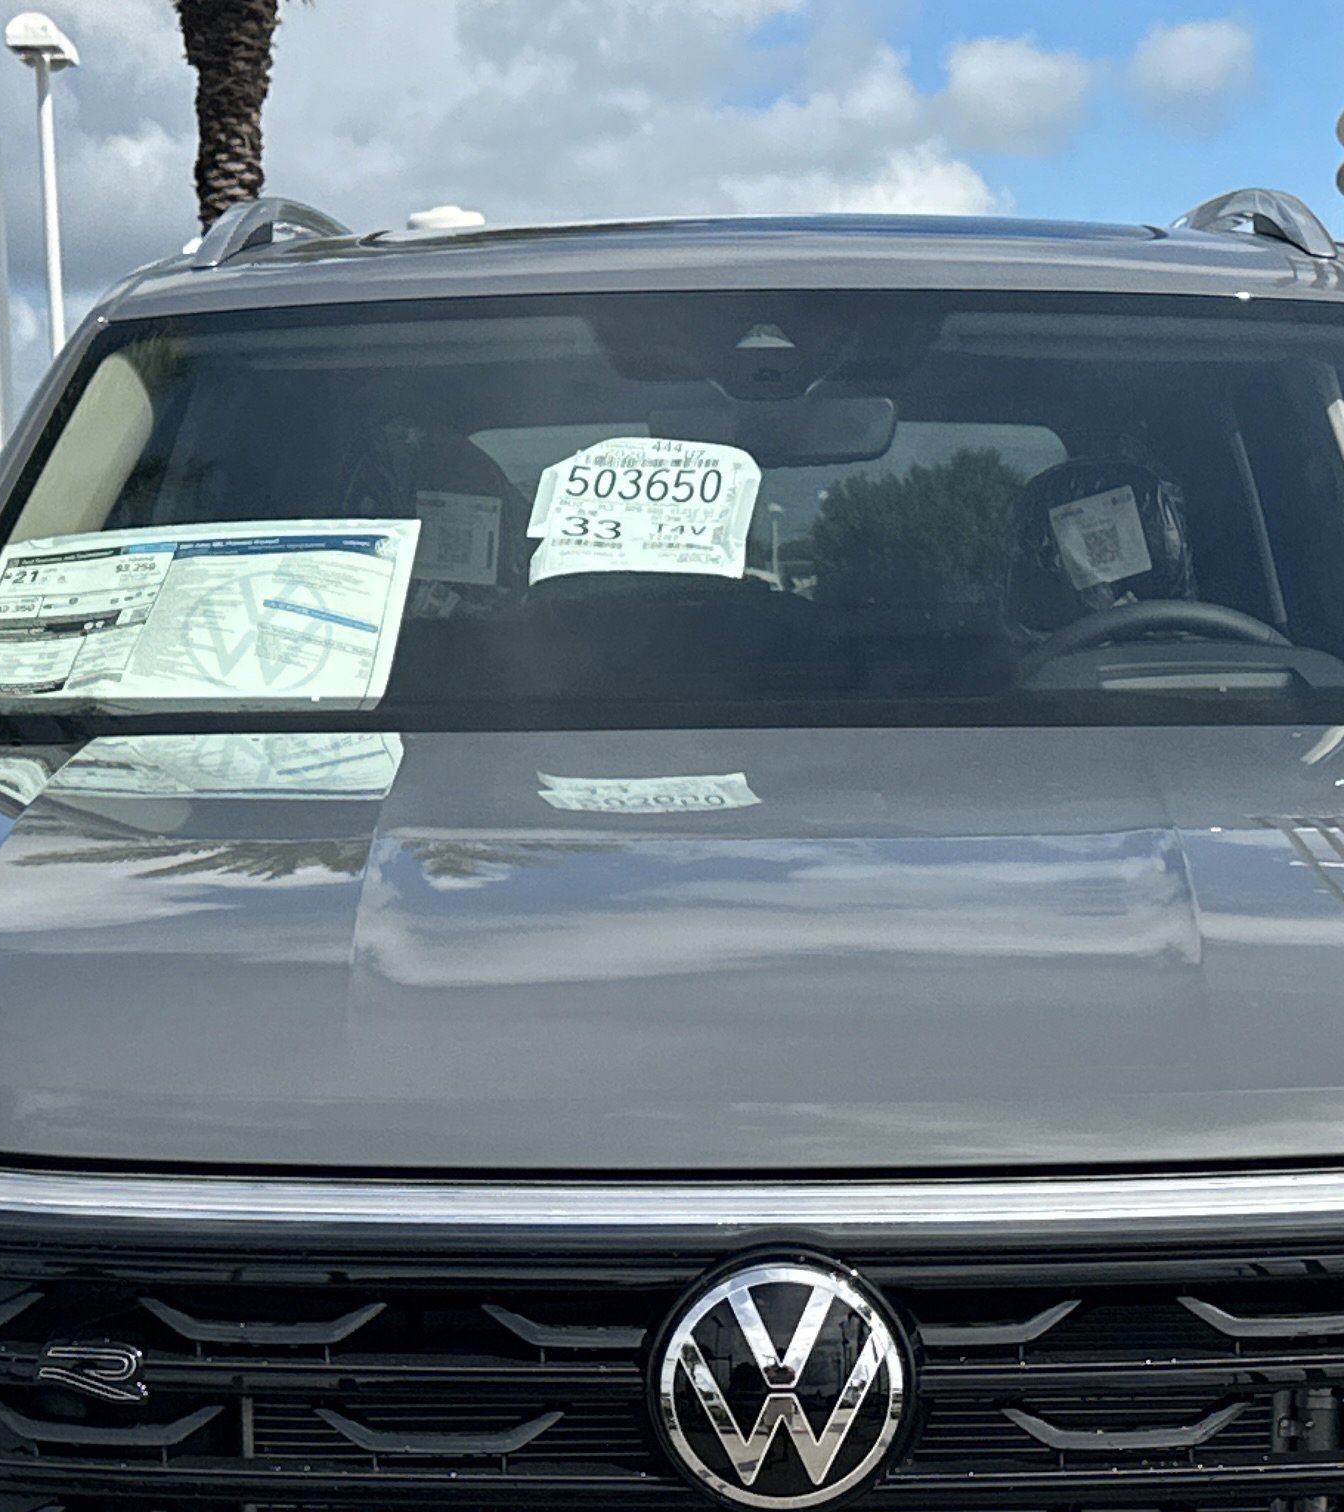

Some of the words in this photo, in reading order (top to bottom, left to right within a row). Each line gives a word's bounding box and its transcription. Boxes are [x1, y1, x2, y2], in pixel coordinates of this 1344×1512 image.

[564, 465, 723, 503] 503650
[561, 516, 622, 540] 33
[12, 570, 39, 584] 21
